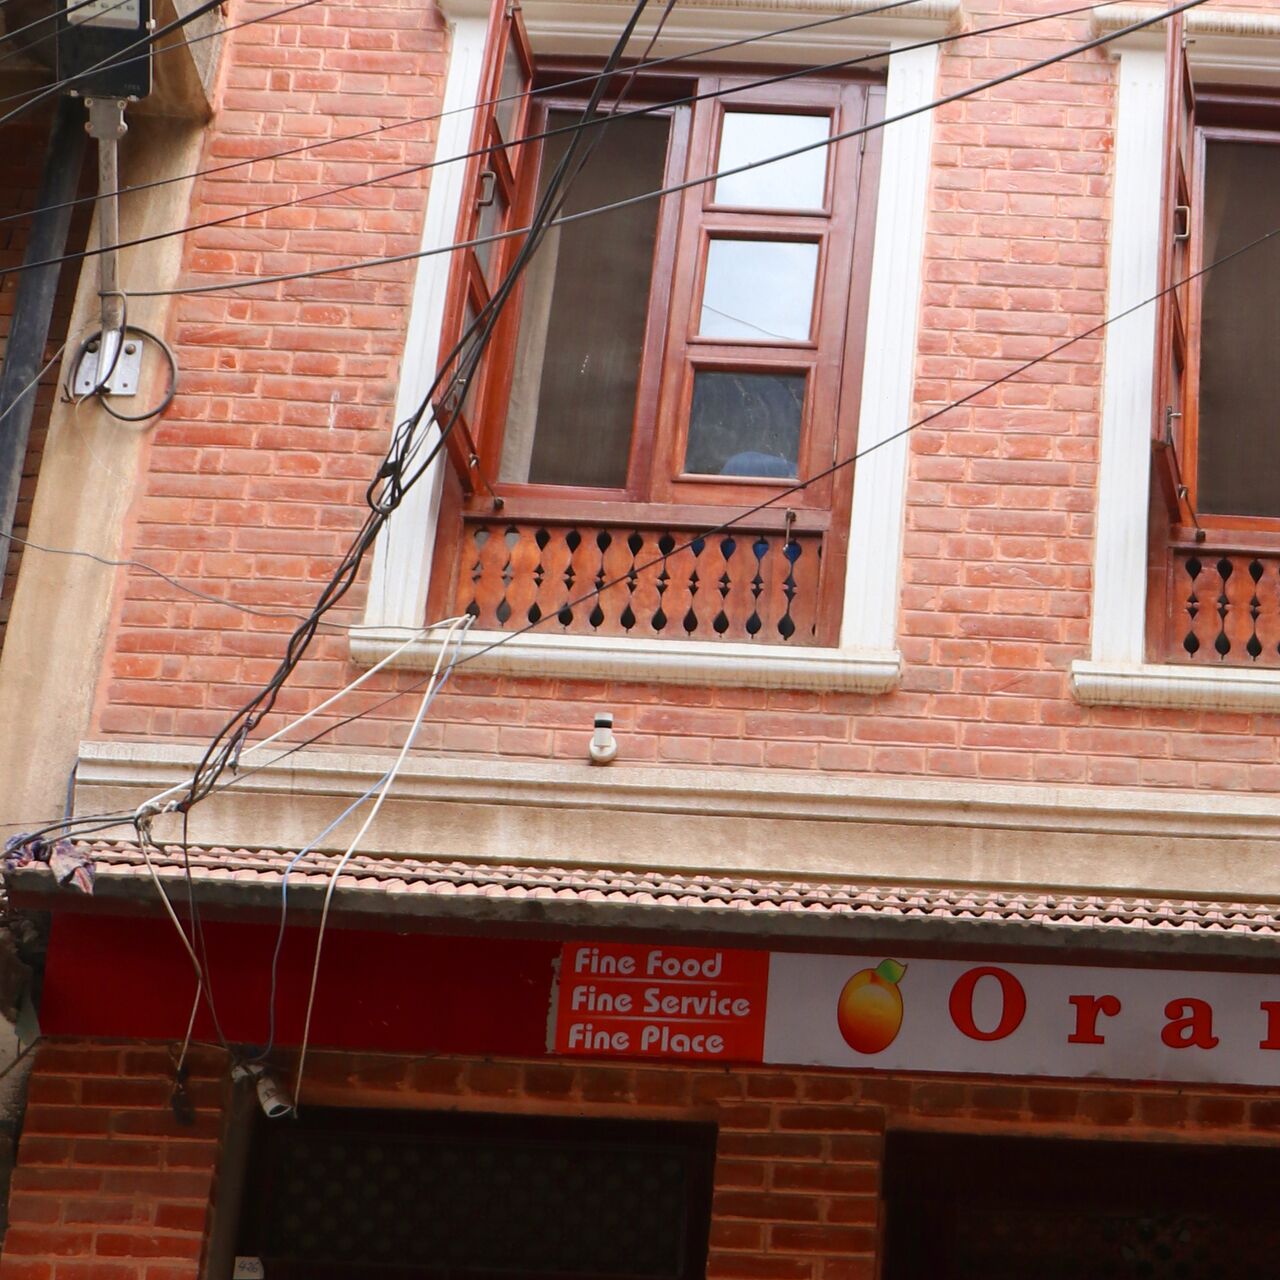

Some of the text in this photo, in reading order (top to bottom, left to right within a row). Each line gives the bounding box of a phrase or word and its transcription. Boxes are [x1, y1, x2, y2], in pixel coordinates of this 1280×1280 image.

[574, 947, 723, 979] Fine Food
[571, 985, 751, 1017] Fine Service
[568, 1023, 725, 1055] Fine Place
